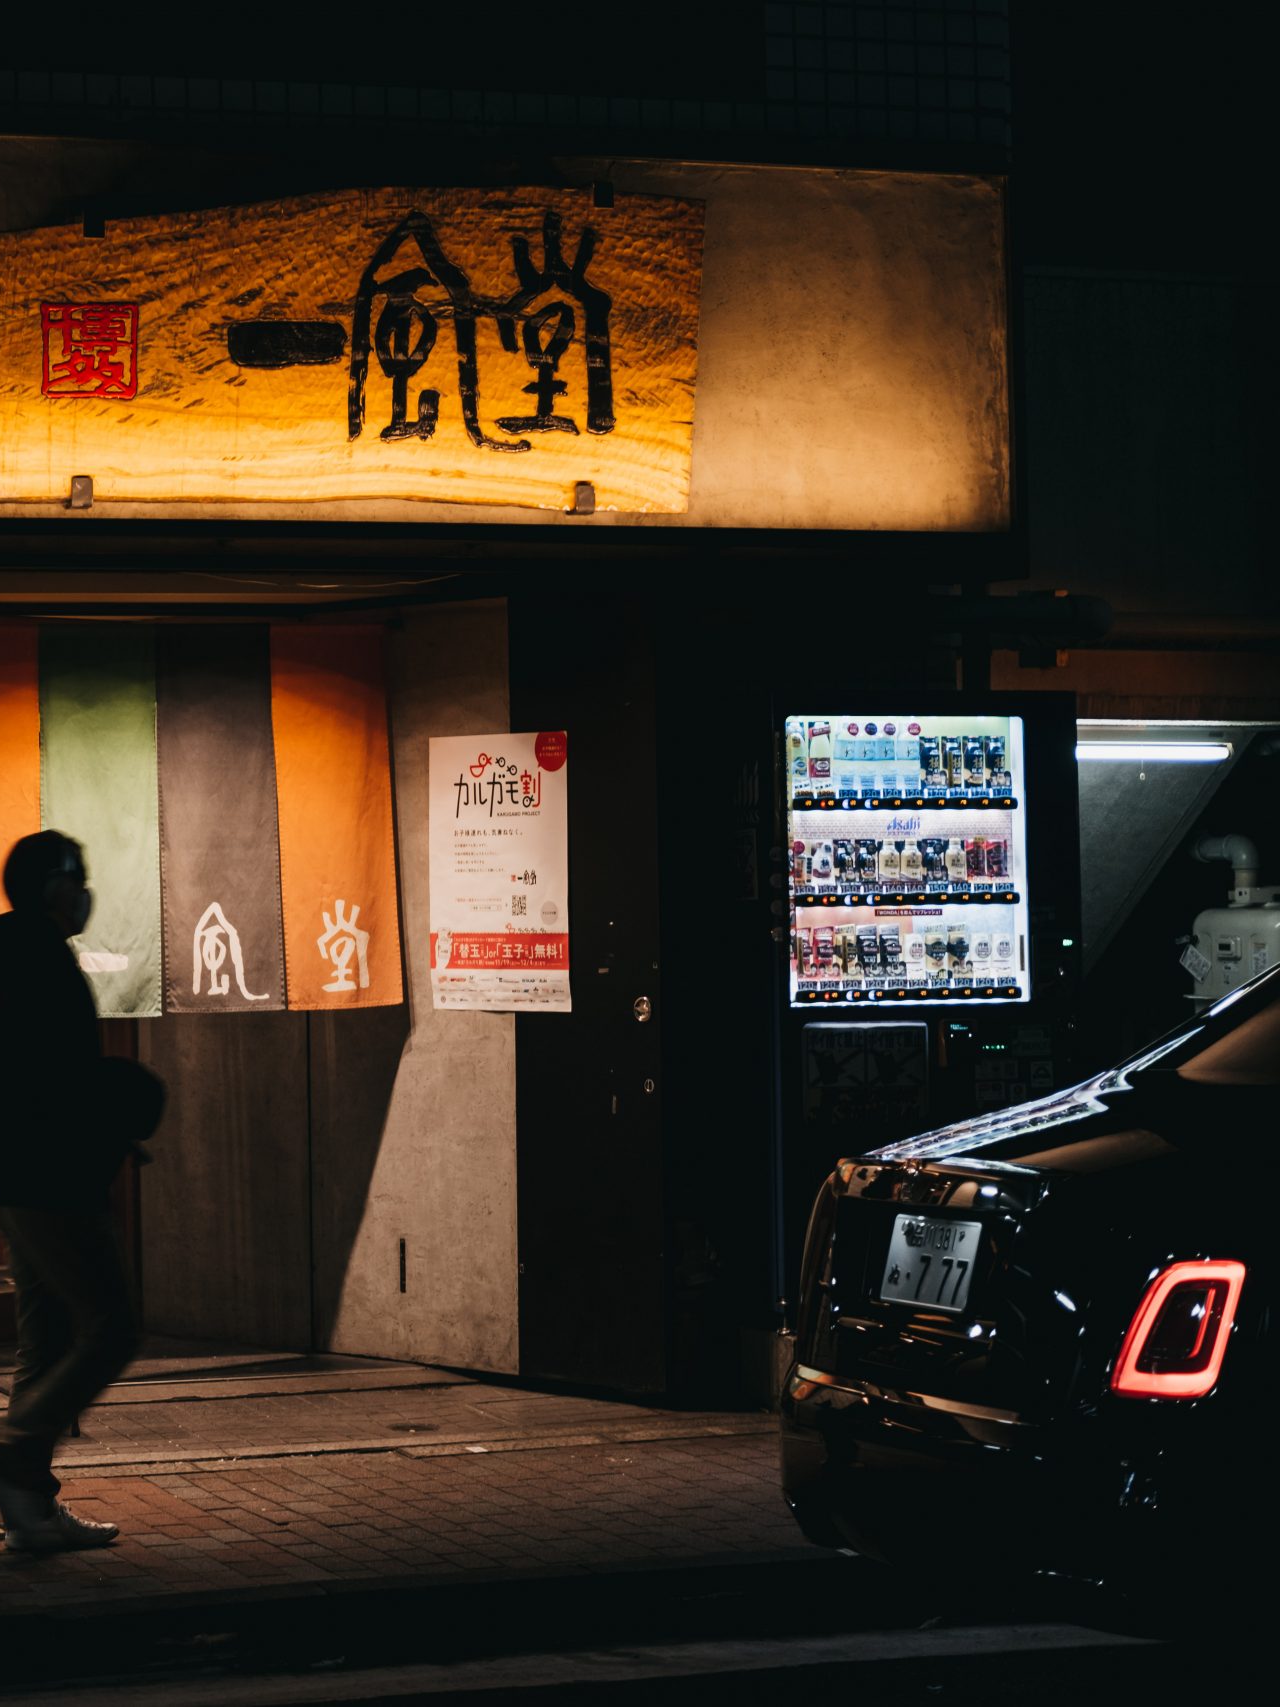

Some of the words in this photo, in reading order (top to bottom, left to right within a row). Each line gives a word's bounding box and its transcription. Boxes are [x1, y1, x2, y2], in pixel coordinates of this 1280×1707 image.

[227, 209, 616, 453] 一風堂
[887, 816, 920, 830] Asahi
